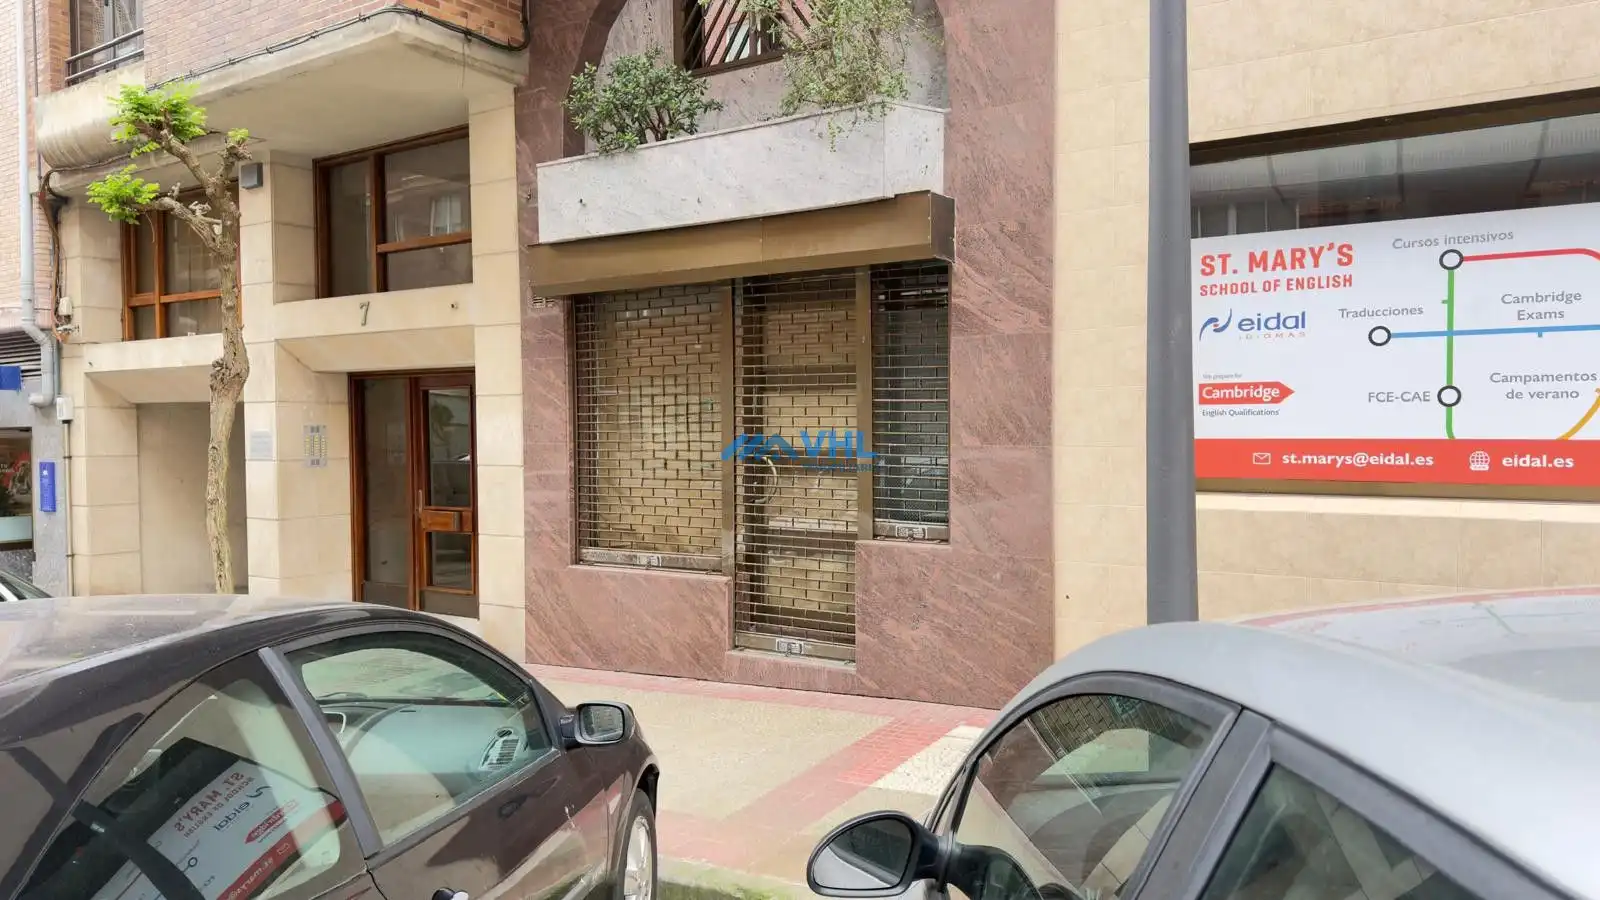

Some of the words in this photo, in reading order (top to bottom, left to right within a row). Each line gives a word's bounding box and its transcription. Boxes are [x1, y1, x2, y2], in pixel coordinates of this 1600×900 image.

[1392, 237, 1440, 250] Cursos
[1443, 230, 1514, 246] intensivos
[1200, 253, 1238, 277] ST.
[1248, 242, 1354, 274] MARY'S
[1199, 282, 1258, 297] SCHOOL
[1262, 279, 1281, 292] OF
[1286, 274, 1353, 291] ENGLISH
[1501, 291, 1582, 305] Cambridge
[359, 301, 370, 326] 7
[1338, 305, 1424, 319] Traducciones
[1516, 309, 1565, 321] Exams
[1237, 310, 1307, 332] eidal
[1489, 371, 1598, 387] Campamentos
[1202, 384, 1280, 402] Cambridge
[1367, 391, 1431, 403] FCE-CAE
[1505, 388, 1524, 400] de
[1528, 389, 1580, 400] verano
[1202, 409, 1227, 417] English
[1228, 408, 1280, 417] Qualifications
[1282, 452, 1434, 468] st.marys@eidal.es
[1502, 453, 1574, 468] eidal.es
